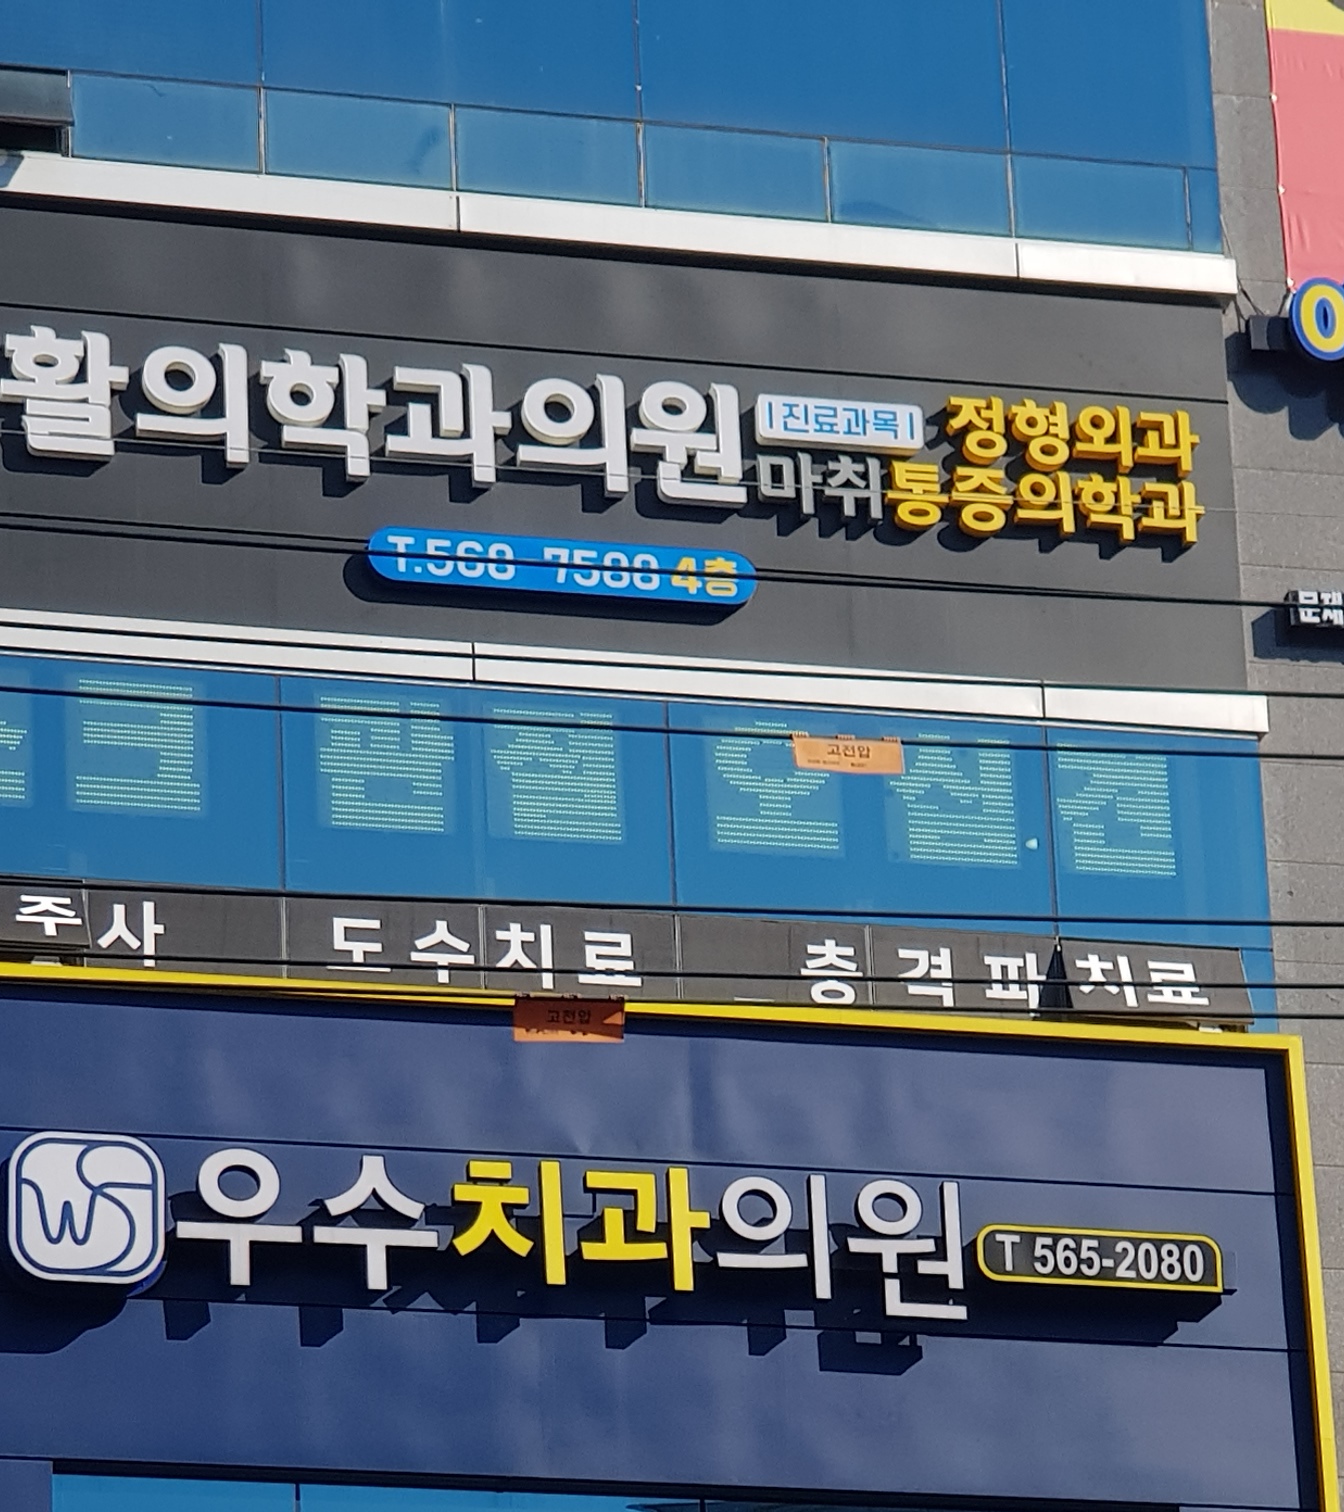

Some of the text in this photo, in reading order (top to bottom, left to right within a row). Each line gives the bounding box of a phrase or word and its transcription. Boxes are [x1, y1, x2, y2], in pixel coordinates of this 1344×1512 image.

[948, 395, 1200, 478] 정형외과
[670, 556, 739, 598] 4층
[827, 743, 871, 760] 고전압
[176, 1148, 968, 1321] 우수치과의원
[1033, 1236, 1205, 1283] 565-2080
